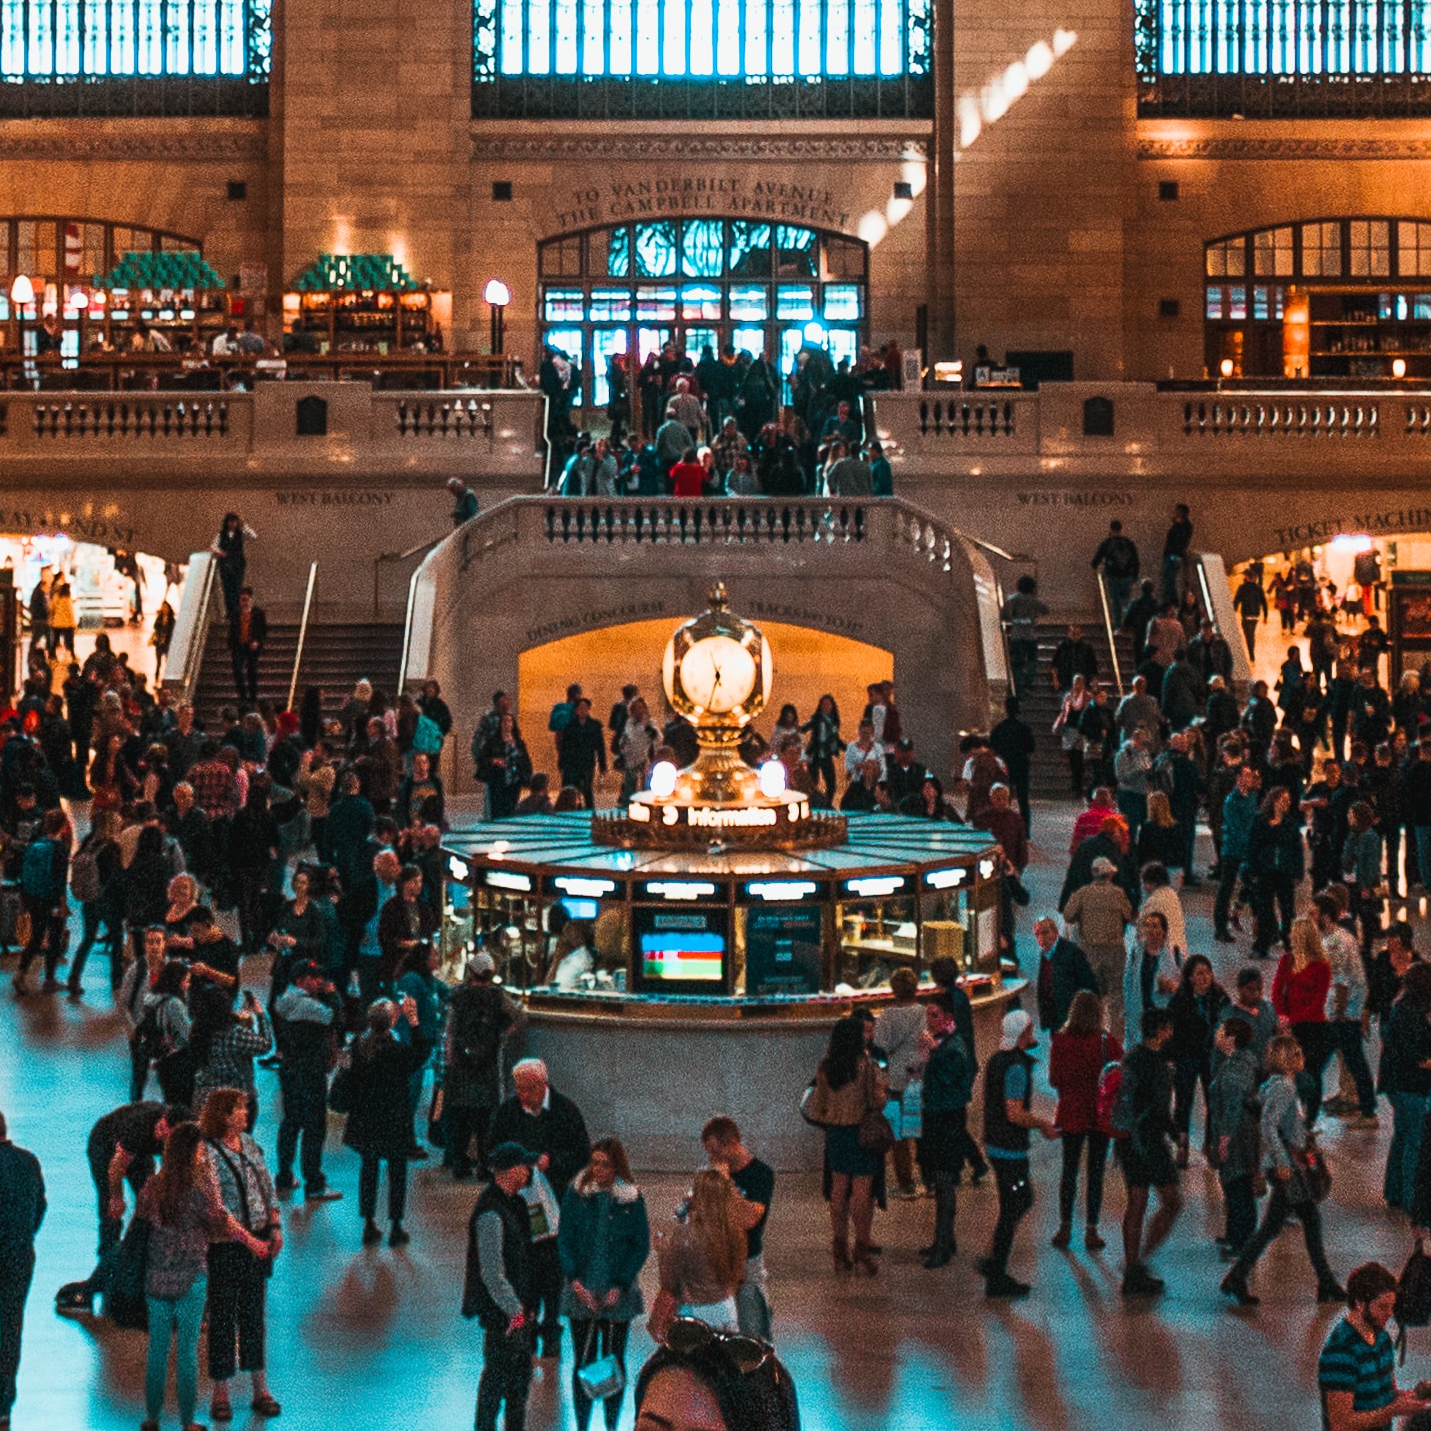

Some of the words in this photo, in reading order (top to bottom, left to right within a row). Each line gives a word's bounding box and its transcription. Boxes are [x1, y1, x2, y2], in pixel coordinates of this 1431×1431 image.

[574, 188, 601, 205] TO
[612, 177, 739, 197] VANDERBILT
[753, 180, 835, 206] AVENUE
[558, 207, 597, 227] THE
[609, 196, 716, 215] CAMPBELL
[727, 196, 850, 227] APARTMENT
[275, 492, 316, 505] WEST
[321, 491, 394, 505] BALCONY
[1016, 492, 1057, 506] WEST
[1062, 492, 1132, 506] BALCONY
[1274, 518, 1343, 545] TICKET
